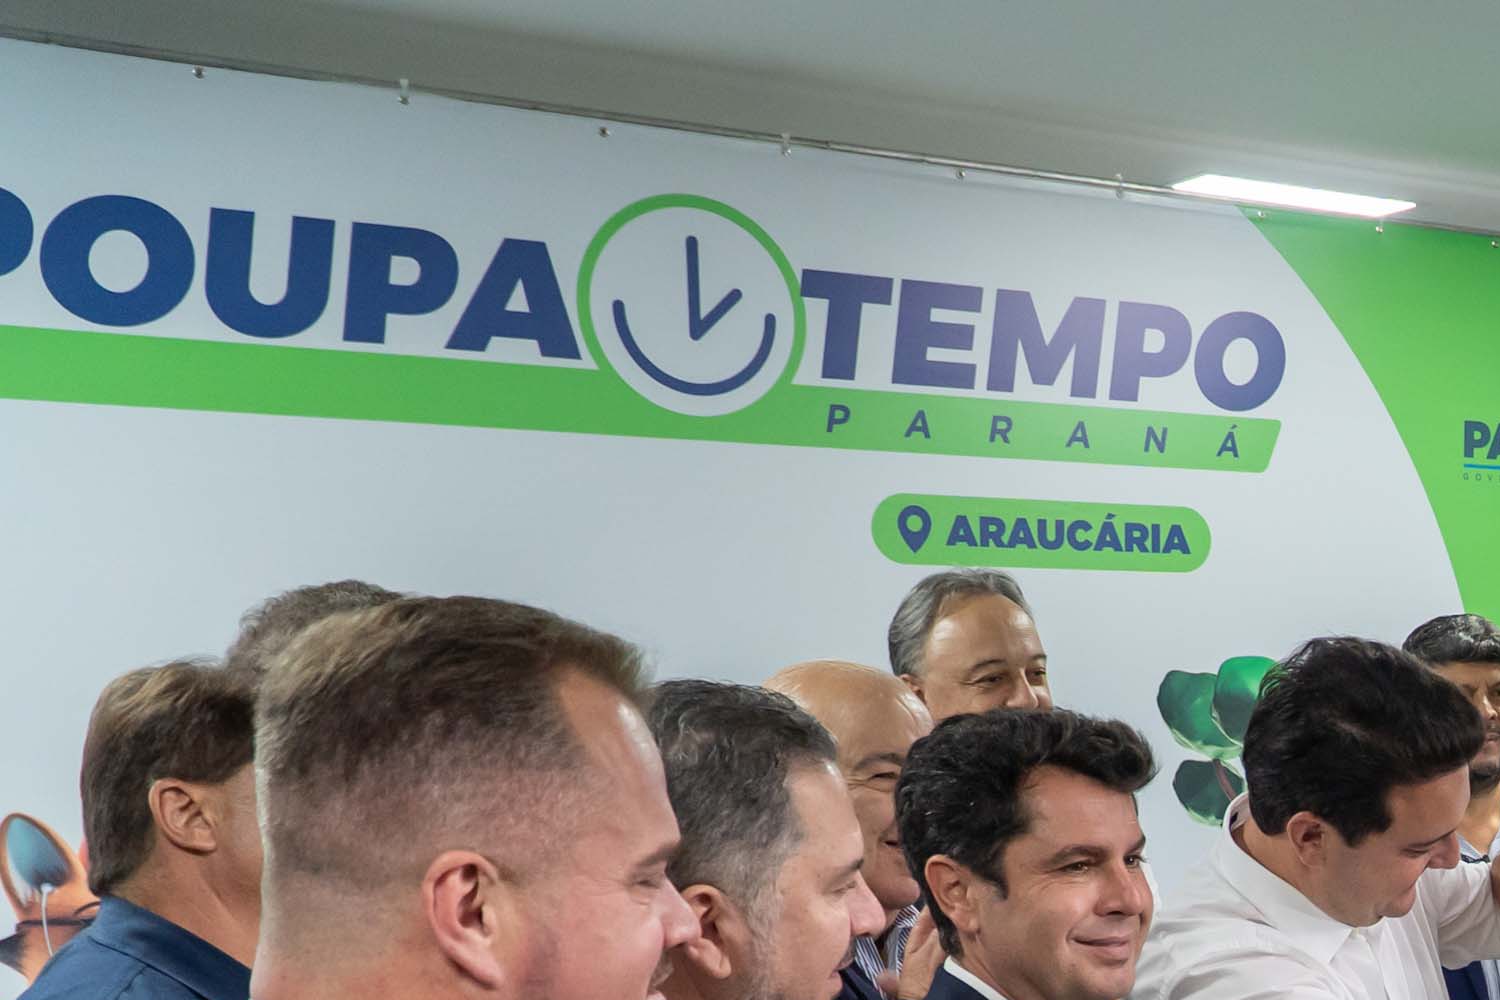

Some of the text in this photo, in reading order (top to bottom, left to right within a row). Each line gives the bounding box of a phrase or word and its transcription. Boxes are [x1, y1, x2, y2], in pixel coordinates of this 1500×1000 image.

[0, 187, 1286, 411] OUPA TEMPO
[825, 404, 1240, 458] PARANÁ
[946, 514, 1192, 555] ARAUCÁRIA
